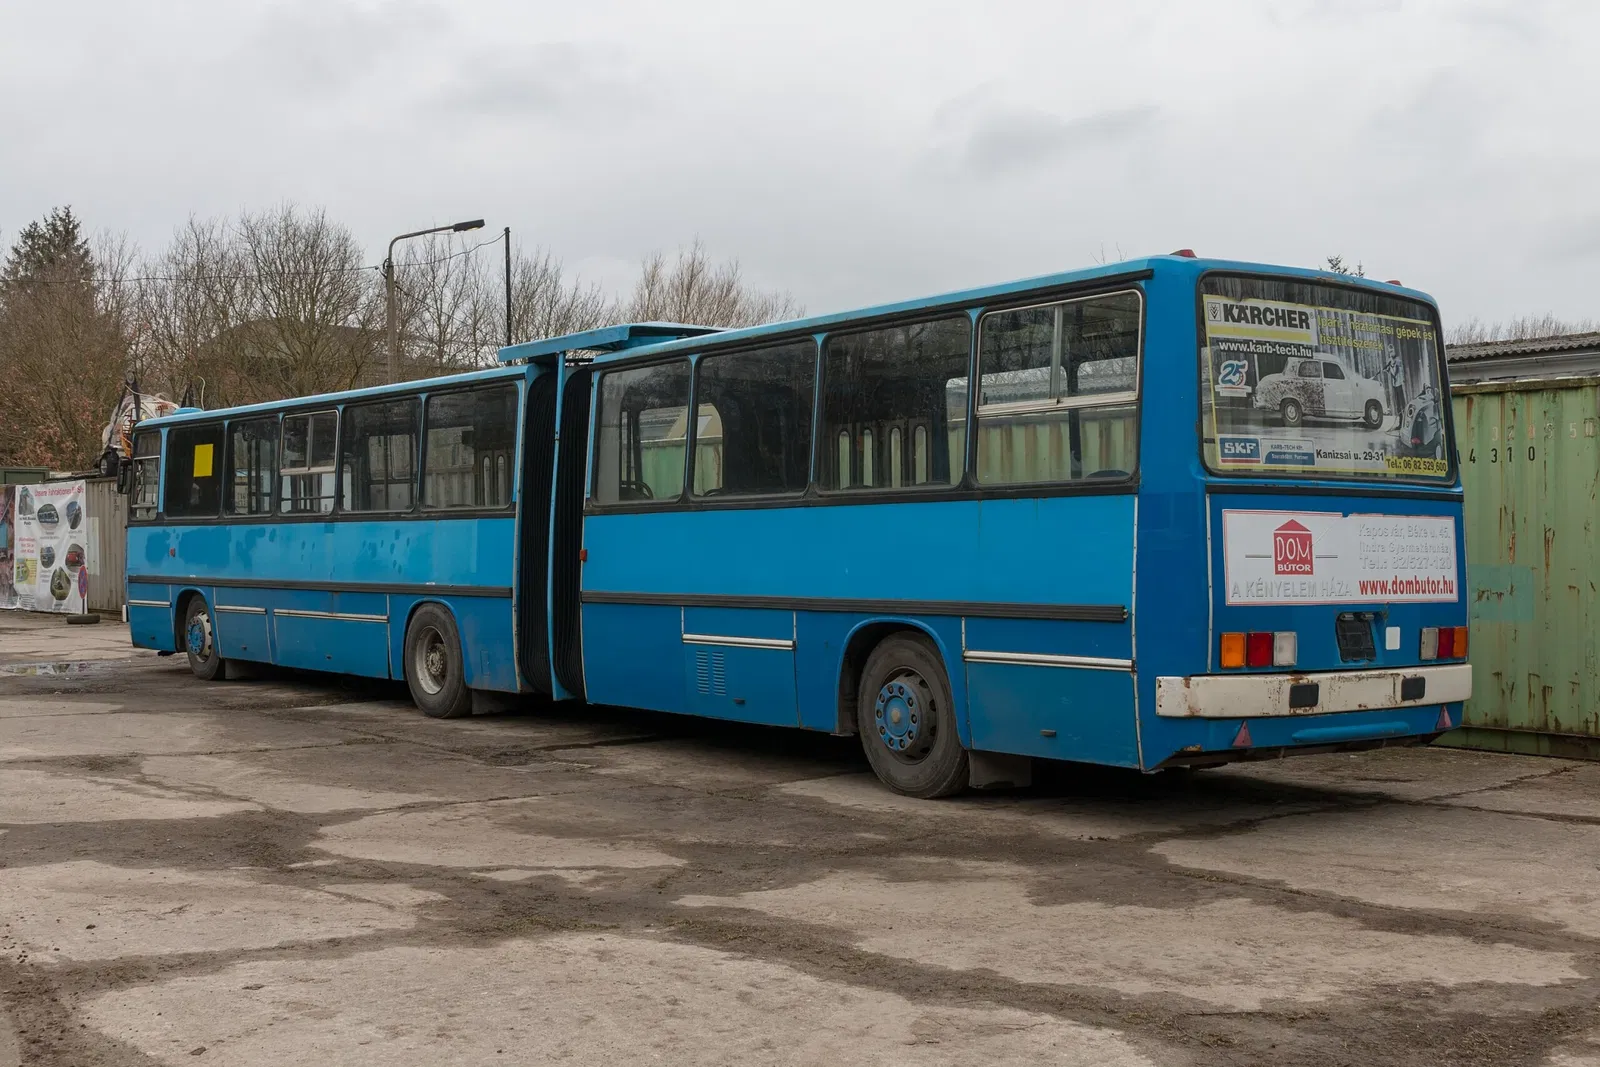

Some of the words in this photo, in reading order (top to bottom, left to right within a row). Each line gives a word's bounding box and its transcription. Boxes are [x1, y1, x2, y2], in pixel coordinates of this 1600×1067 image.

[1222, 303, 1311, 330] KÄRCHER
[1396, 325, 1422, 340] gépek
[1423, 329, 1433, 341] és
[1219, 340, 1312, 357] www.karb-tech.hu
[1224, 442, 1257, 454] SKF
[1316, 449, 1352, 460] Kanizsai
[1363, 451, 1384, 461] 29-31
[1386, 459, 1401, 469] Tel.:
[1403, 460, 1411, 469] 06
[1423, 461, 1434, 471] 529
[1436, 462, 1447, 472] 600
[1275, 536, 1311, 562] DOM
[1277, 562, 1312, 572] BÚTOR
[1231, 579, 1242, 598] A
[1245, 577, 1317, 598] KÉNYELEM
[1321, 576, 1353, 597] HÁZA
[1358, 575, 1454, 595] www.dombutor.hu
